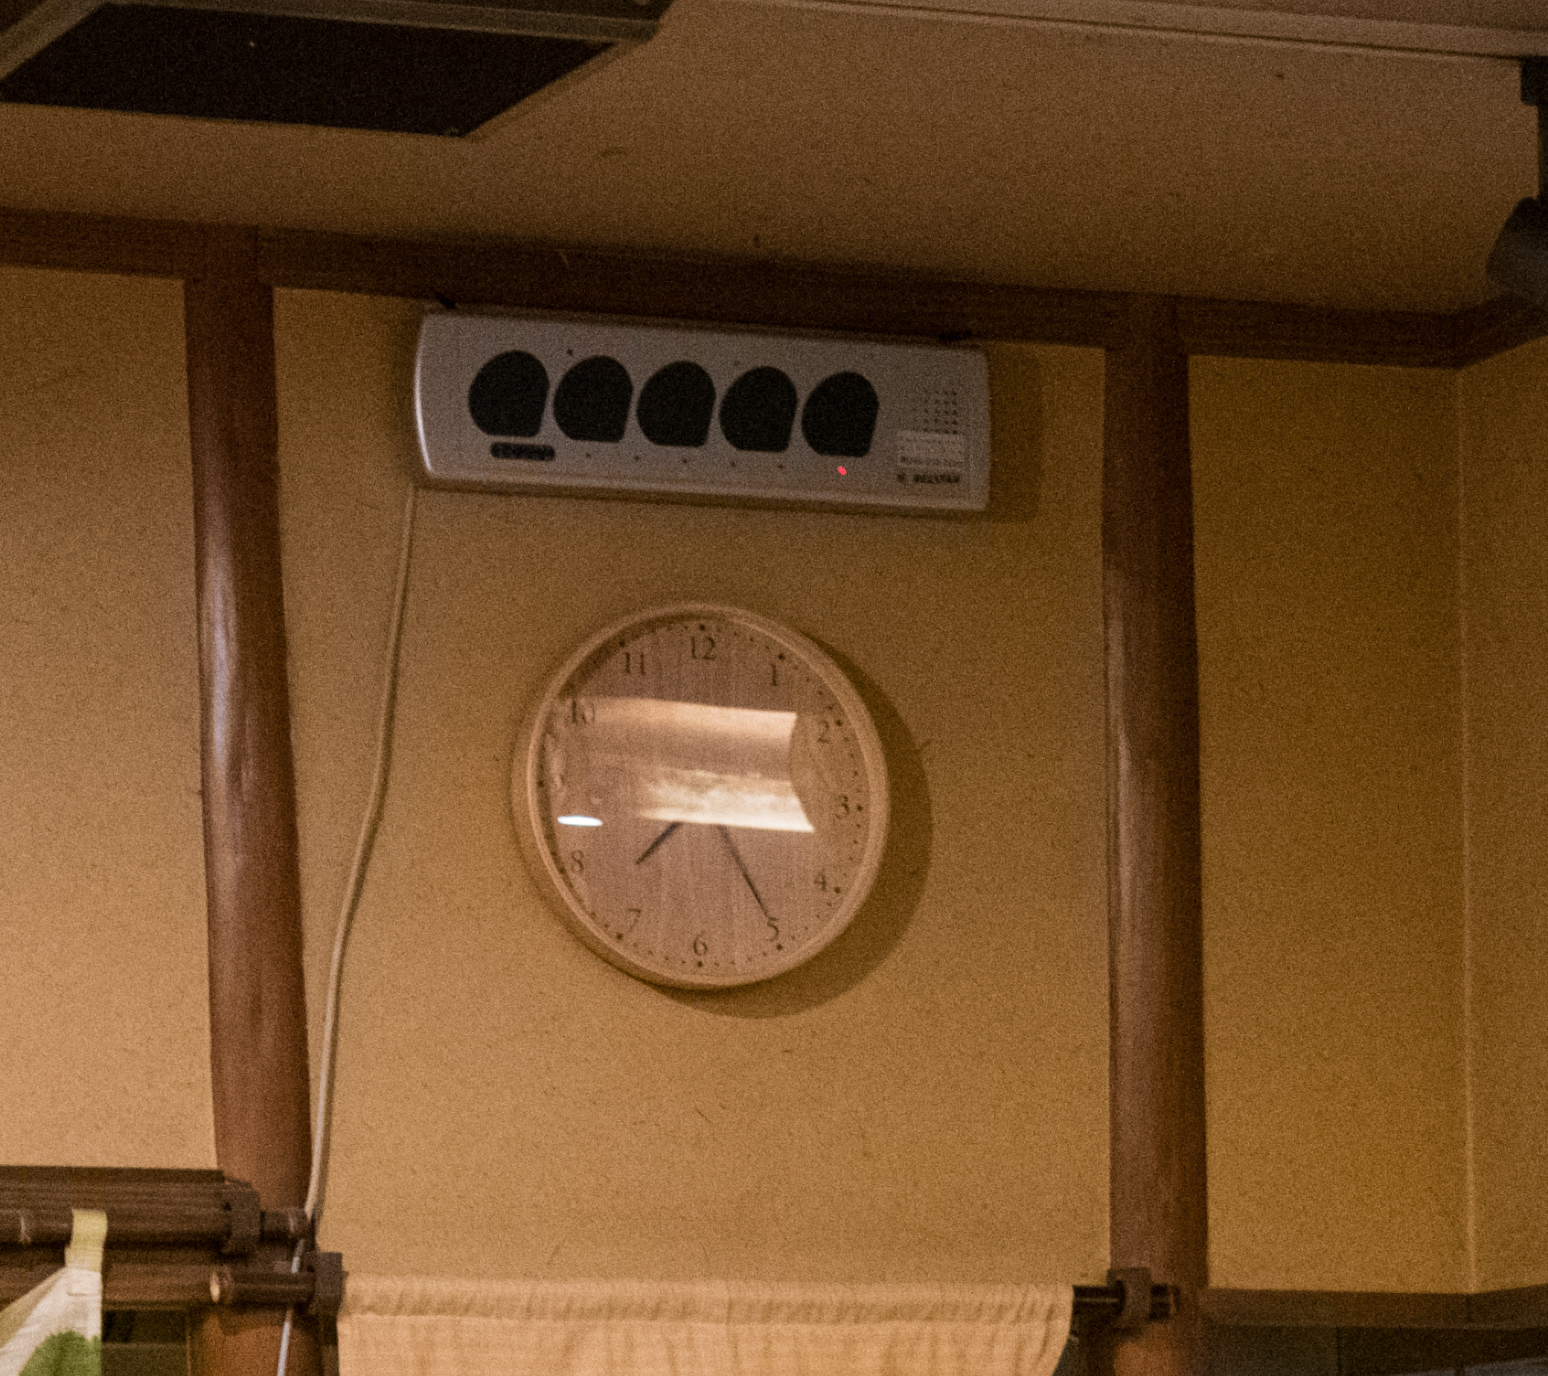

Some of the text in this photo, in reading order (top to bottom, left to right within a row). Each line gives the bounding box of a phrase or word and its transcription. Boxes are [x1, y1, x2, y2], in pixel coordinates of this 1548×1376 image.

[690, 635, 717, 660] 12
[624, 652, 647, 676] 11
[769, 663, 779, 687] 1
[570, 699, 597, 725] 10
[818, 720, 831, 744] 2
[835, 794, 851, 819] 3
[570, 848, 585, 875] 8
[812, 872, 829, 892] 4
[627, 907, 643, 933] 7
[765, 916, 780, 943] 5
[692, 933, 709, 957] 6
